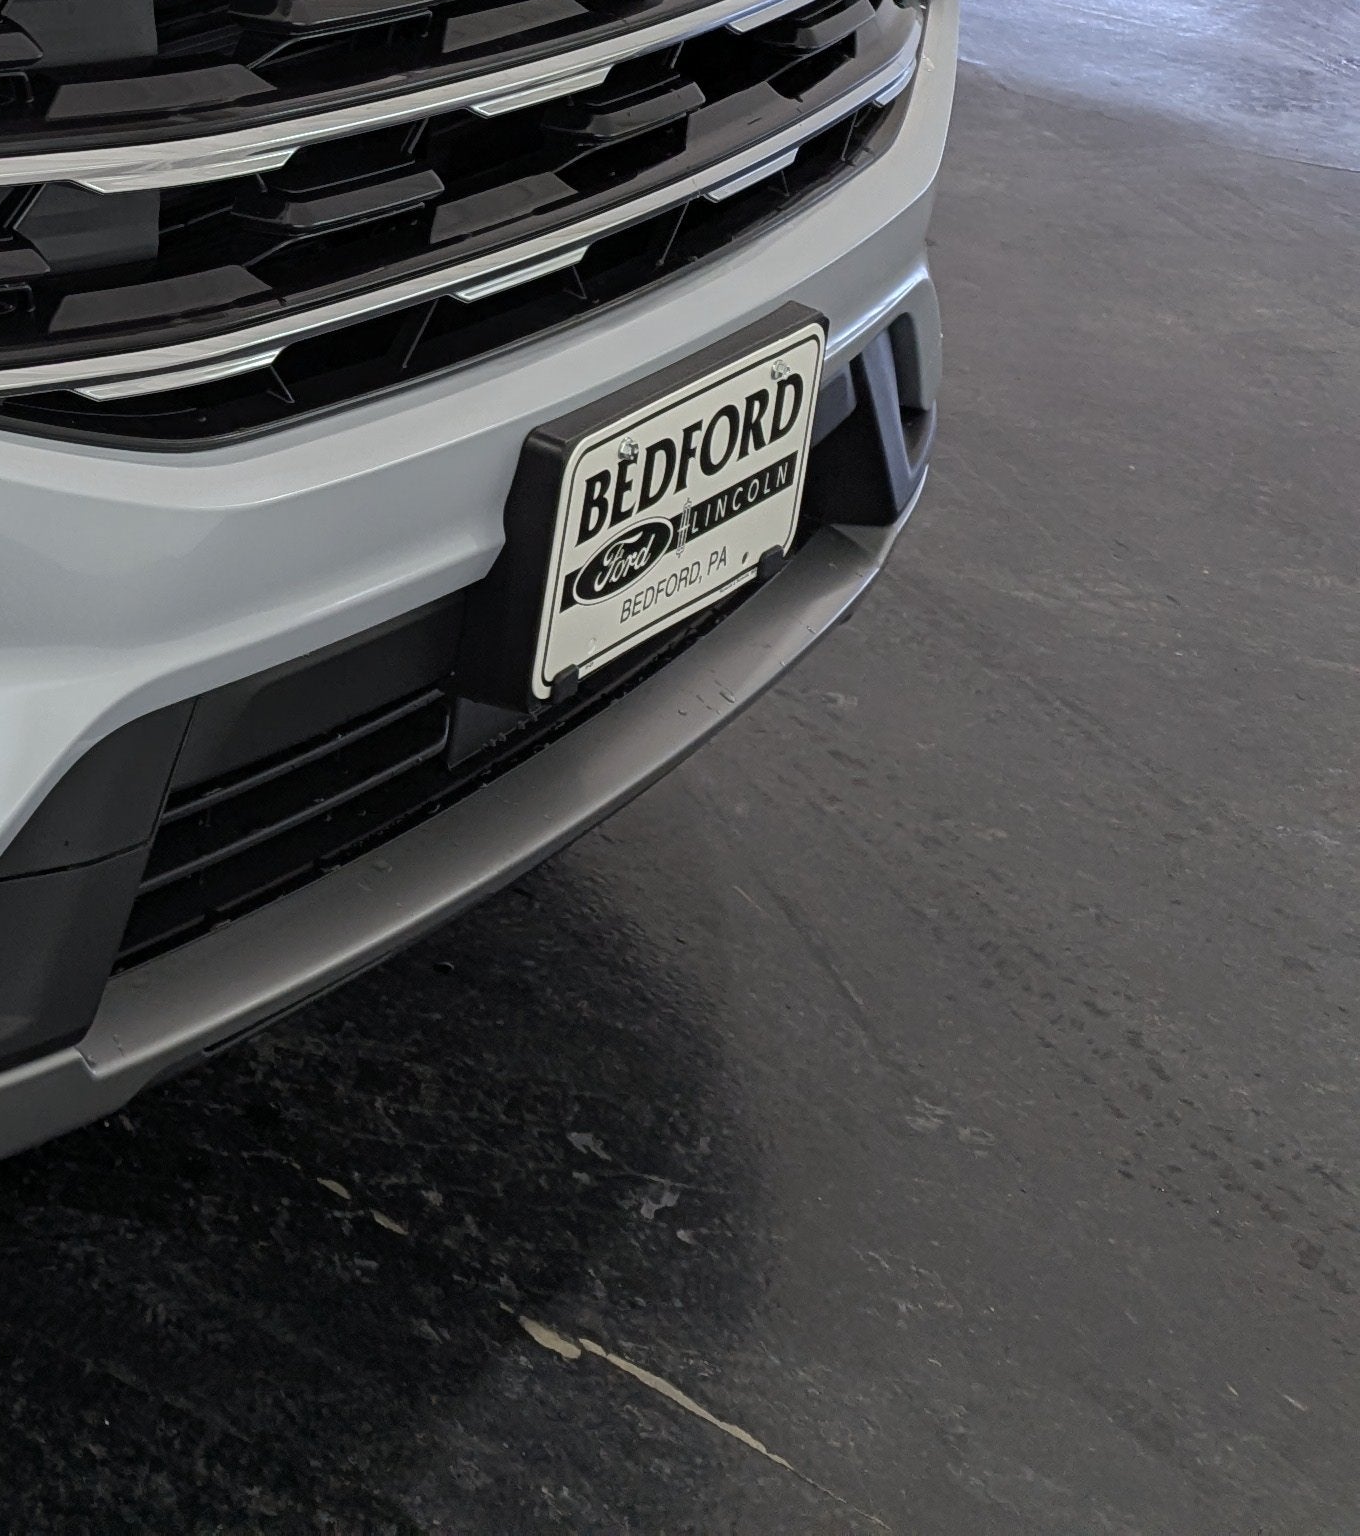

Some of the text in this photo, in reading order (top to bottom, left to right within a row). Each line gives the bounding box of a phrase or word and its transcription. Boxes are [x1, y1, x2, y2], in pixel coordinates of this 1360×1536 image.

[575, 372, 804, 547] BEDFORD
[593, 461, 790, 593] Ford LINCOLN
[620, 560, 702, 624] BEDFORD,
[707, 546, 727, 576] PA
